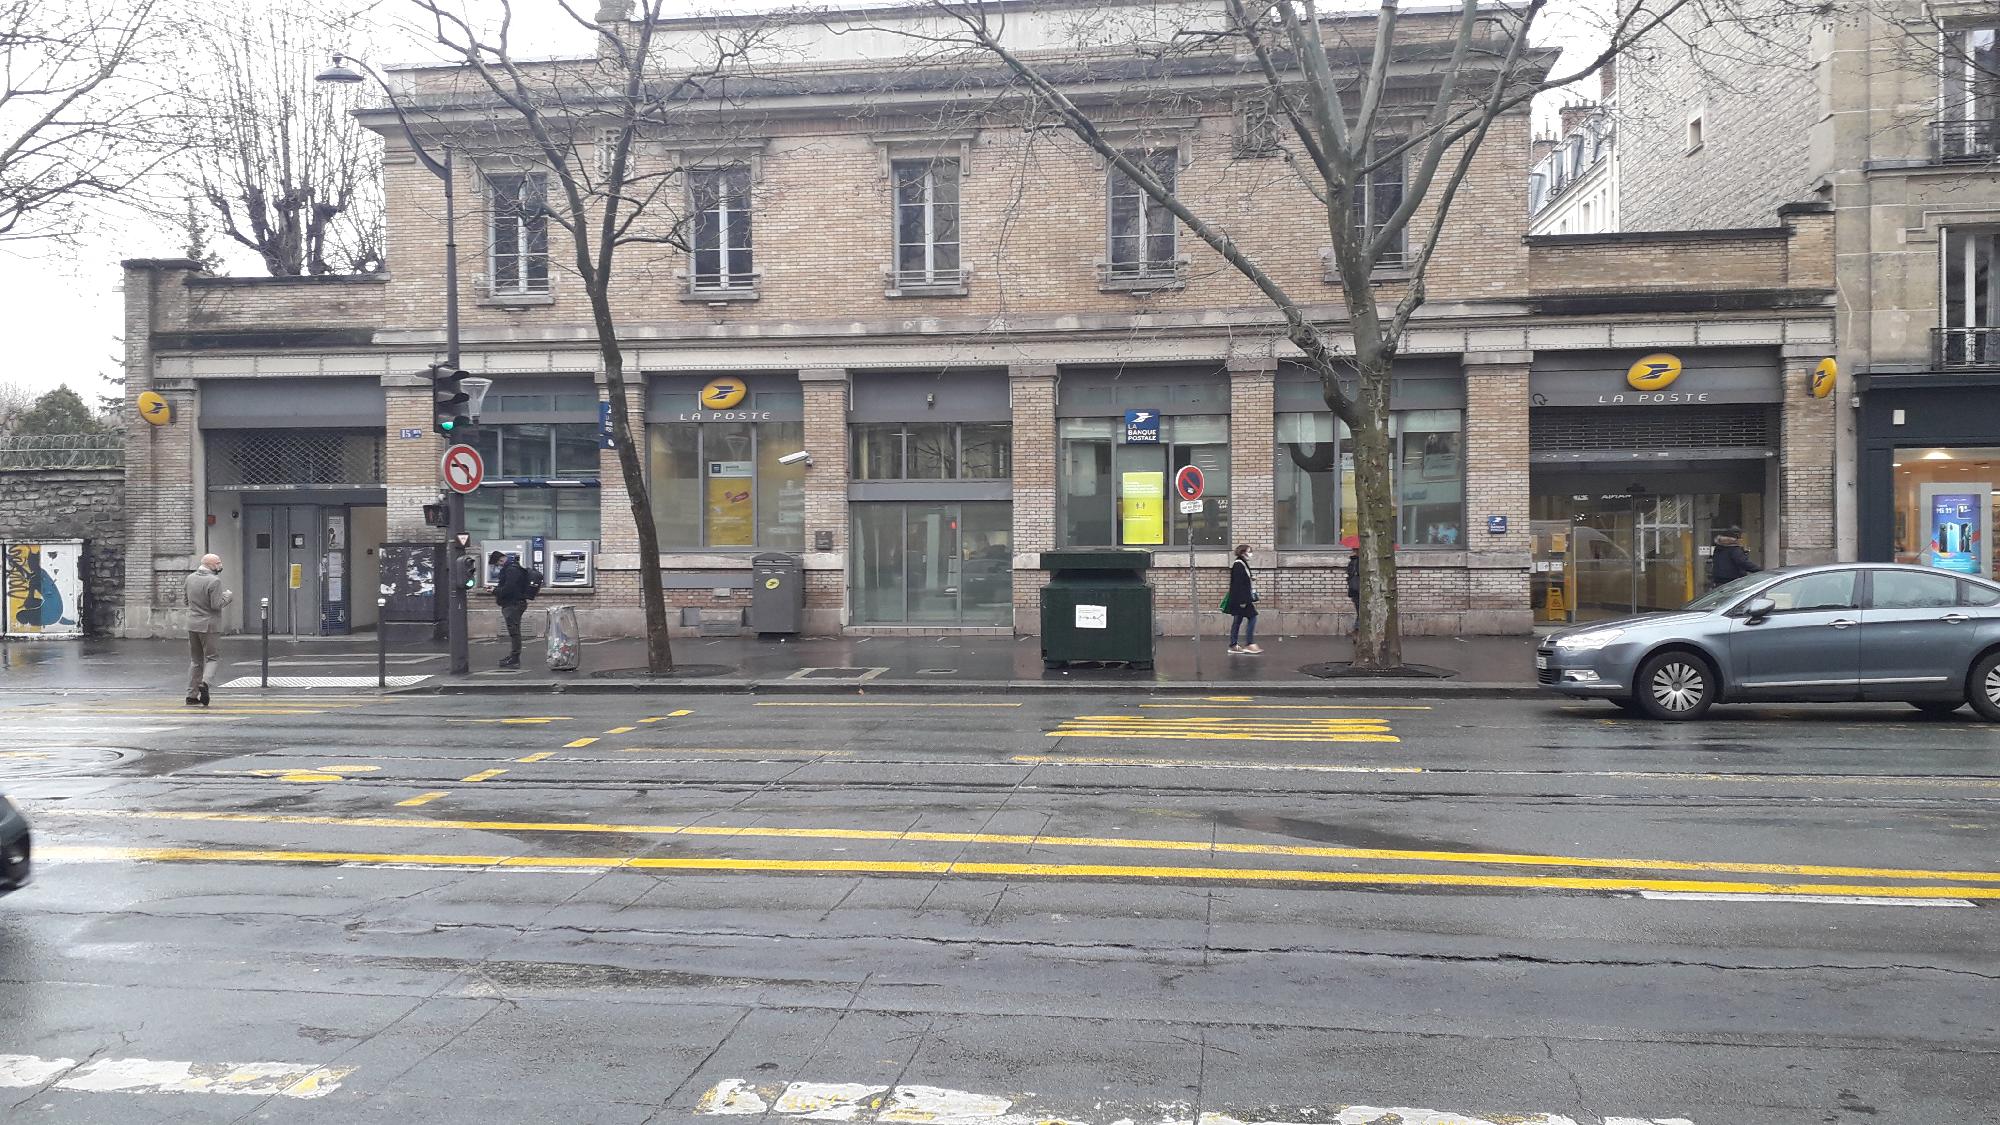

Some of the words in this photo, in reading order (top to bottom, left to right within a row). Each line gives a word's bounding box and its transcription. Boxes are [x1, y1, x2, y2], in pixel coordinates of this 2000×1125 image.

[1599, 394, 1624, 403] LA
[1639, 393, 1709, 402] POSTE
[680, 413, 701, 421] LA
[713, 412, 771, 420] POSTE
[401, 429, 411, 438] 15
